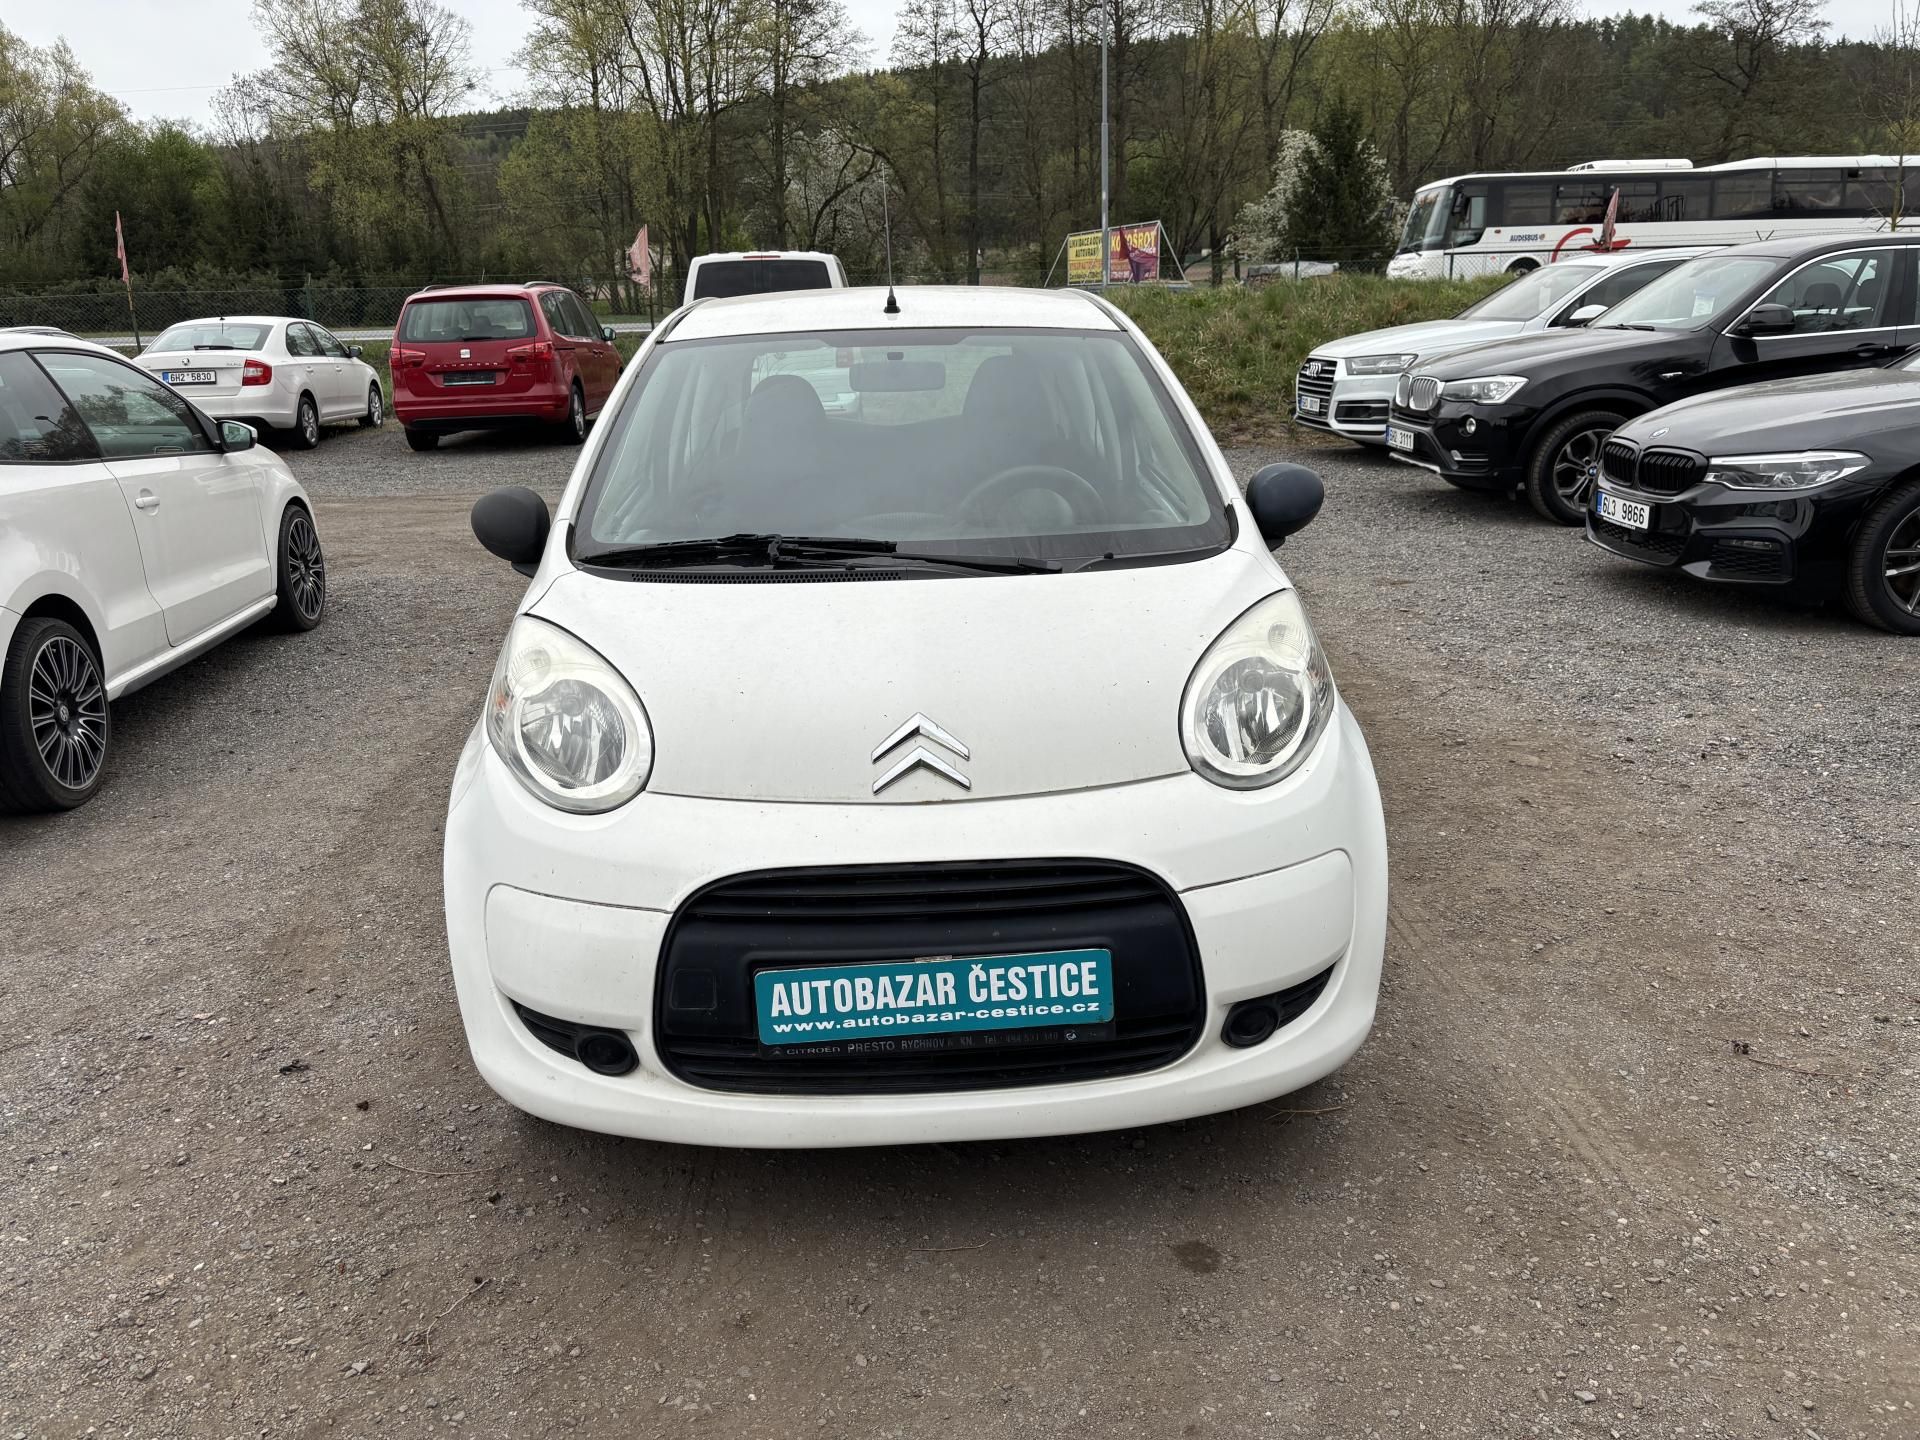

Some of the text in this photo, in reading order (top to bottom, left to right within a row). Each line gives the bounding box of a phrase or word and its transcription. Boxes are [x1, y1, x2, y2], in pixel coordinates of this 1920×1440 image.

[1111, 229, 1156, 252] KOOŠROT
[170, 374, 185, 382] 6H2
[1603, 496, 1616, 516] 6L3
[1622, 503, 1645, 525] 9866
[771, 961, 1099, 1017] AUTOBAZAR ČESTICE
[773, 1003, 1100, 1033] www.autobazar-cestice.cz
[847, 1041, 895, 1053] PRESTO
[901, 1037, 944, 1049] RYCHNOV
